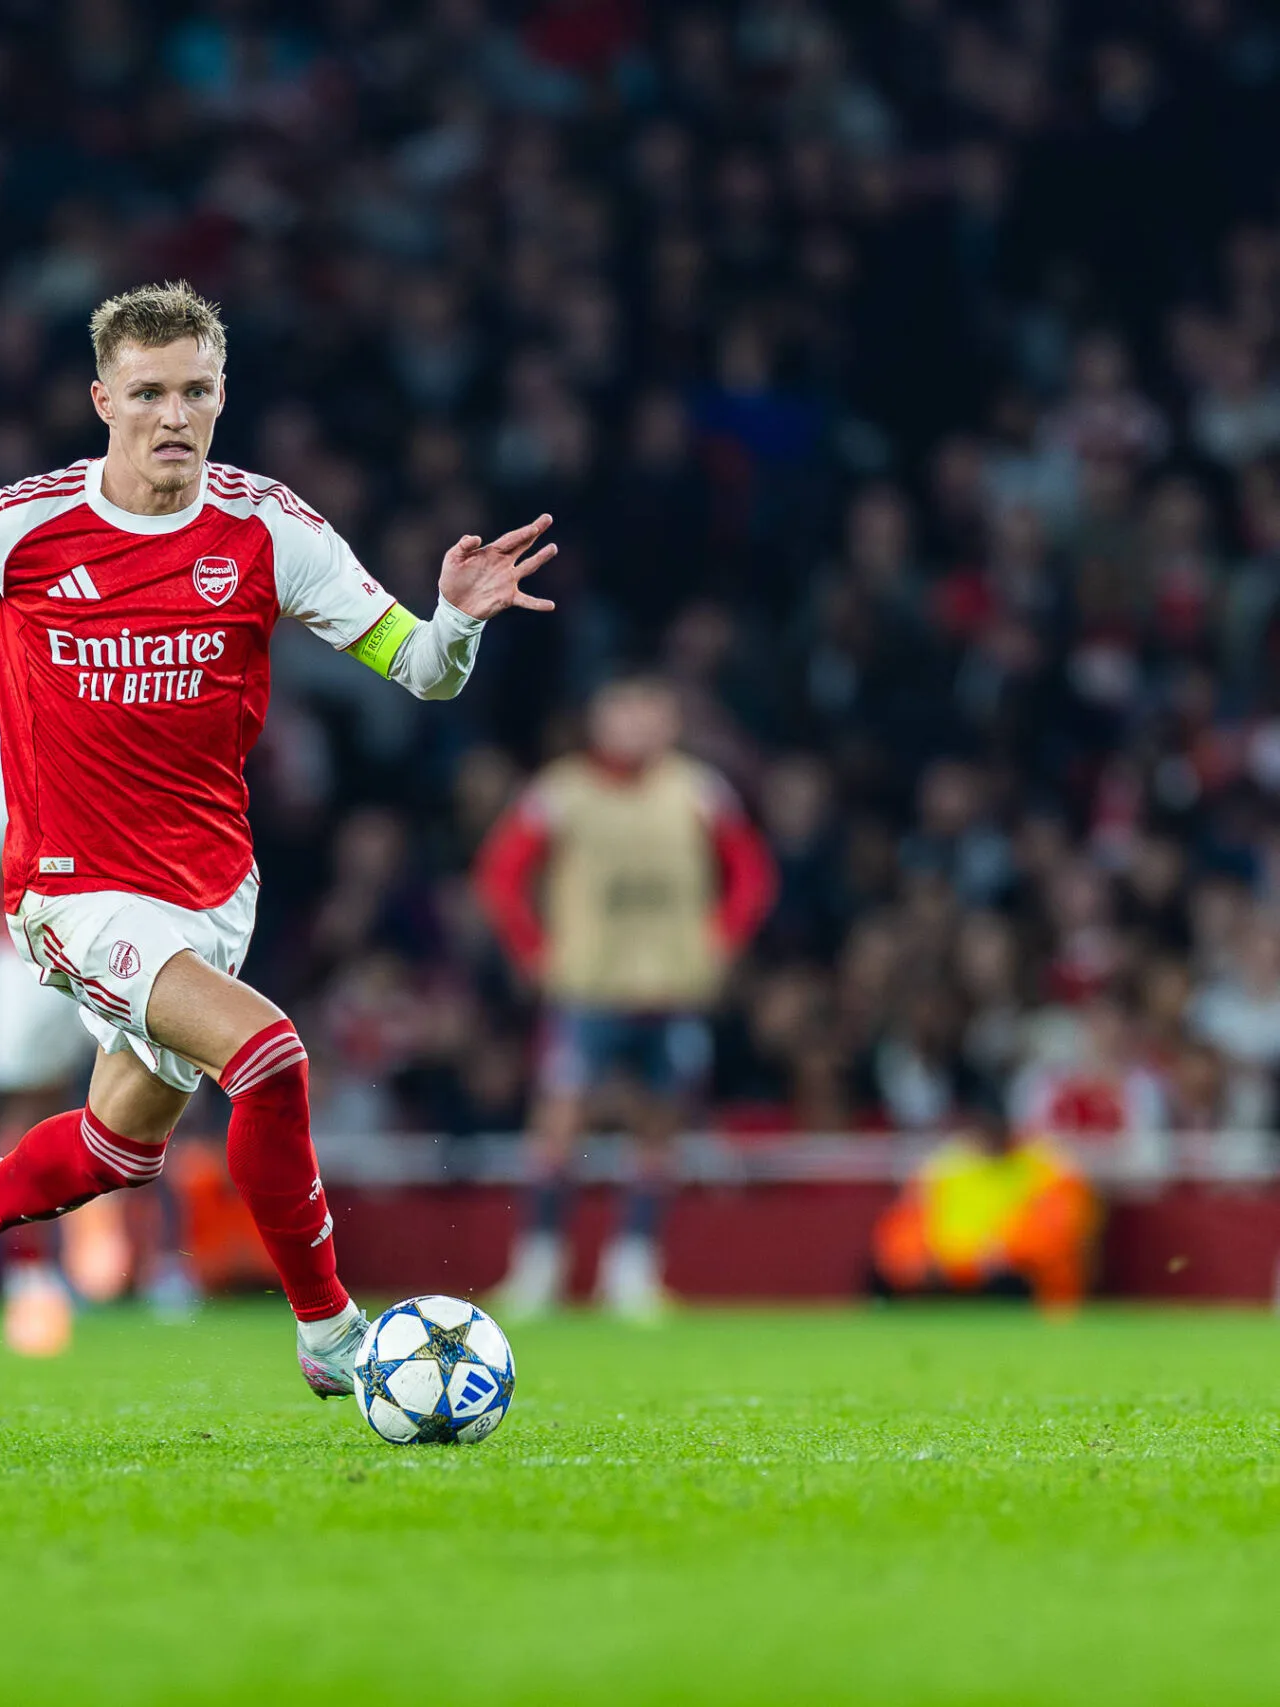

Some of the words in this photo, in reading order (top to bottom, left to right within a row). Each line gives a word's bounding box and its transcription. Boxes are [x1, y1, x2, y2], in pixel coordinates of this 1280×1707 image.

[199, 565, 231, 575] Arsenal
[46, 628, 226, 668] Emirates
[368, 612, 397, 652] RESPECT
[78, 672, 116, 702] FLY
[122, 670, 203, 704] BETTER
